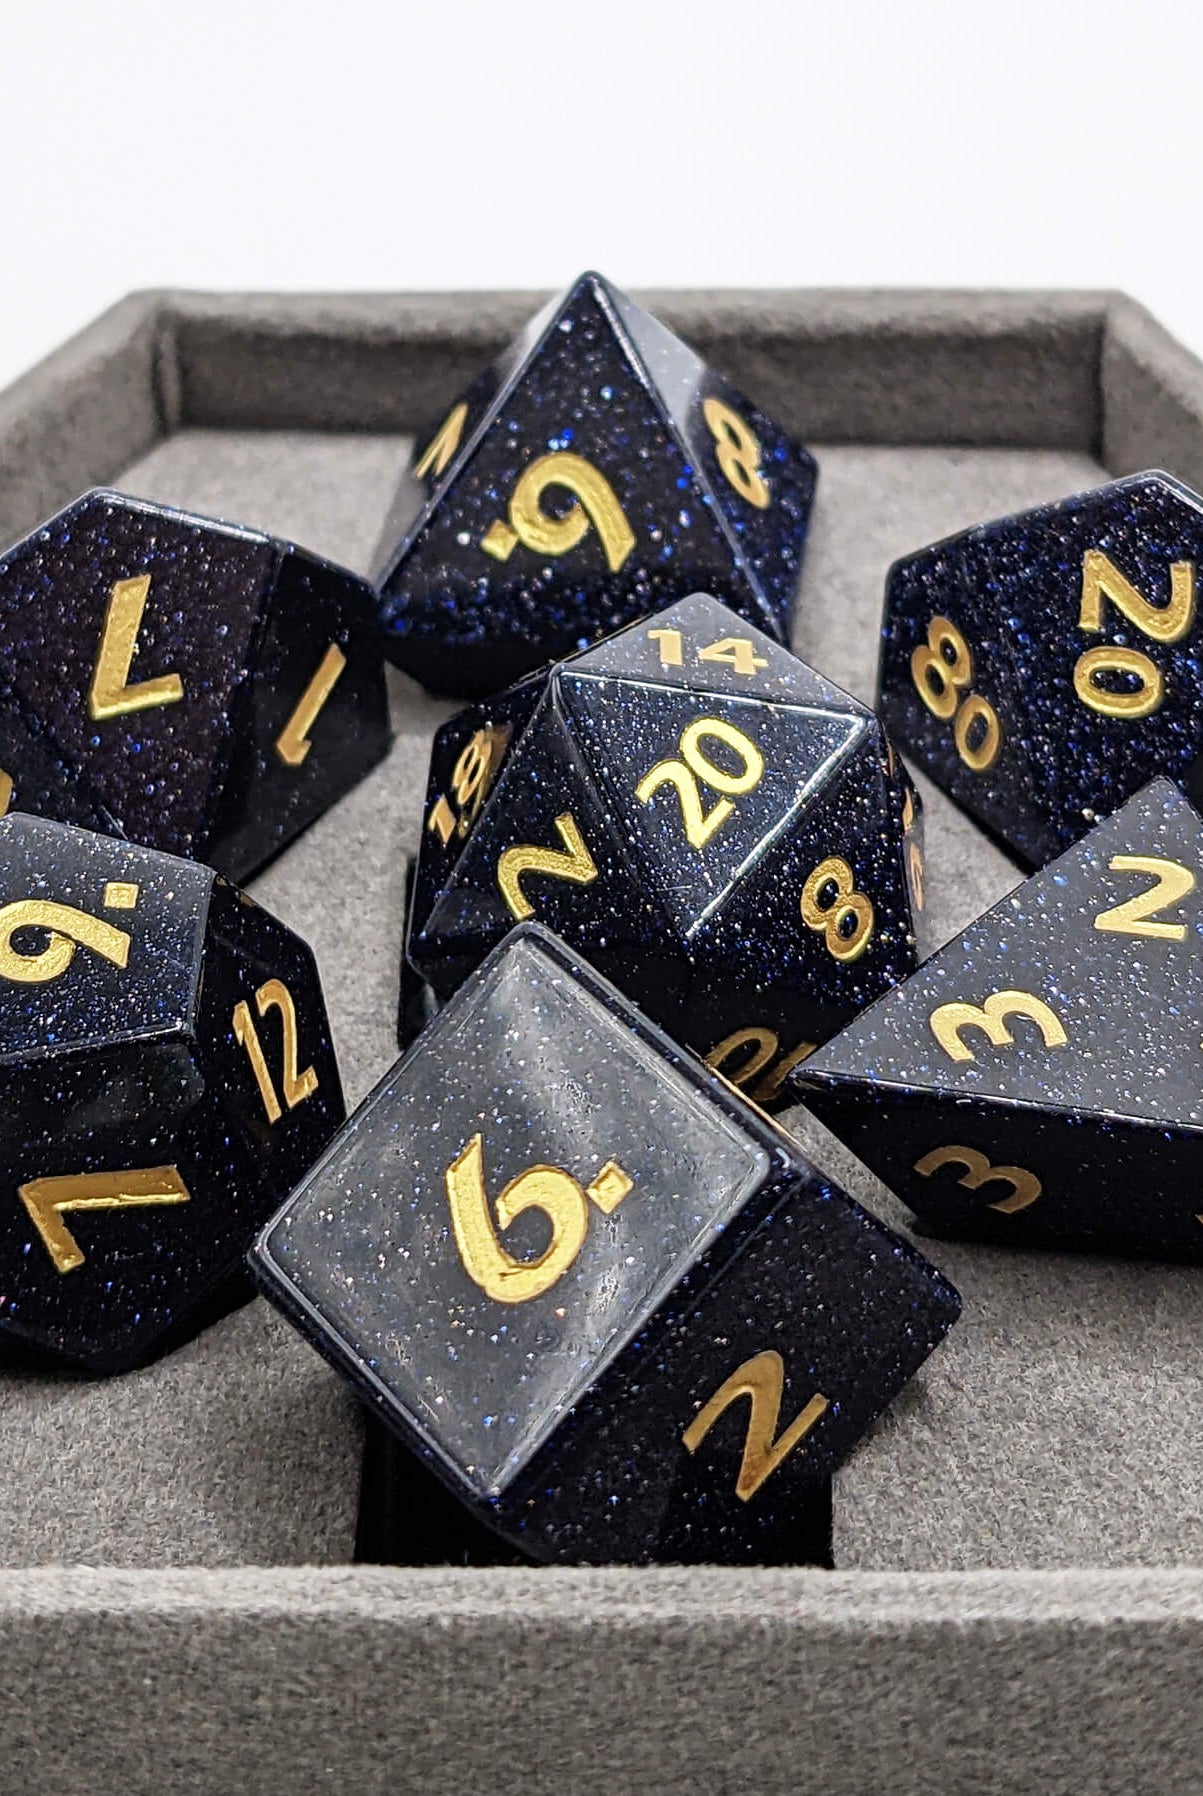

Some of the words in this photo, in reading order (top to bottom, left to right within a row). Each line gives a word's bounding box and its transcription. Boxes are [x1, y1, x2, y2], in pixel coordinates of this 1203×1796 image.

[703, 398, 770, 509] 8
[90, 573, 184, 721] 7
[647, 628, 768, 675] 14
[1073, 550, 1195, 718] 20
[911, 616, 1001, 772] 80
[635, 716, 764, 849] 20
[497, 811, 598, 922] 2
[800, 856, 874, 963] 8
[1094, 855, 1195, 940] 2
[231, 978, 319, 1124] 12
[929, 990, 1068, 1063] 3
[18, 1165, 191, 1274] 7
[913, 1145, 1042, 1214] 3
[682, 1349, 829, 1502] 2
